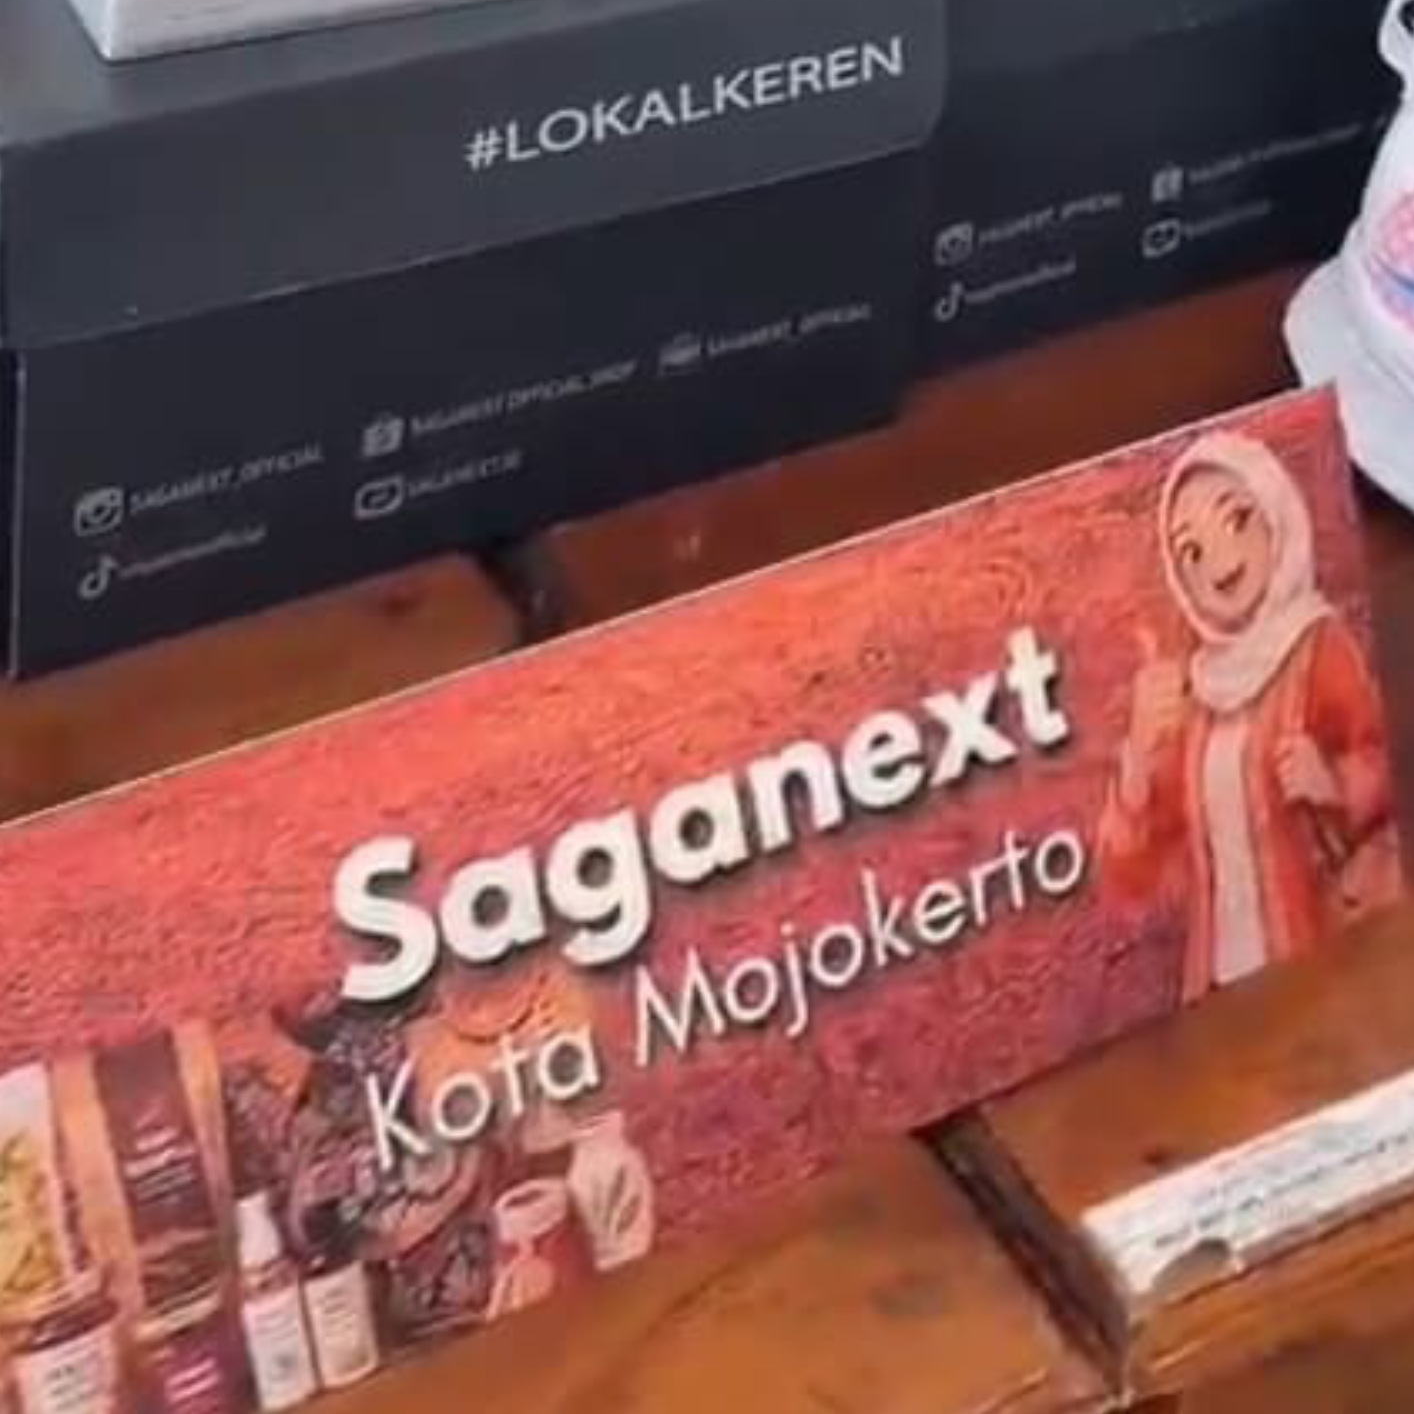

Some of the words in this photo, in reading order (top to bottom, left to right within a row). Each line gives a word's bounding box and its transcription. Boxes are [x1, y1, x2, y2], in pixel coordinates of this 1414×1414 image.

[464, 34, 906, 172] #LOKALKEREN
[332, 627, 1071, 1004] Saganext
[366, 1024, 601, 1170] Kota
[632, 828, 1085, 1070] Mojokerto
